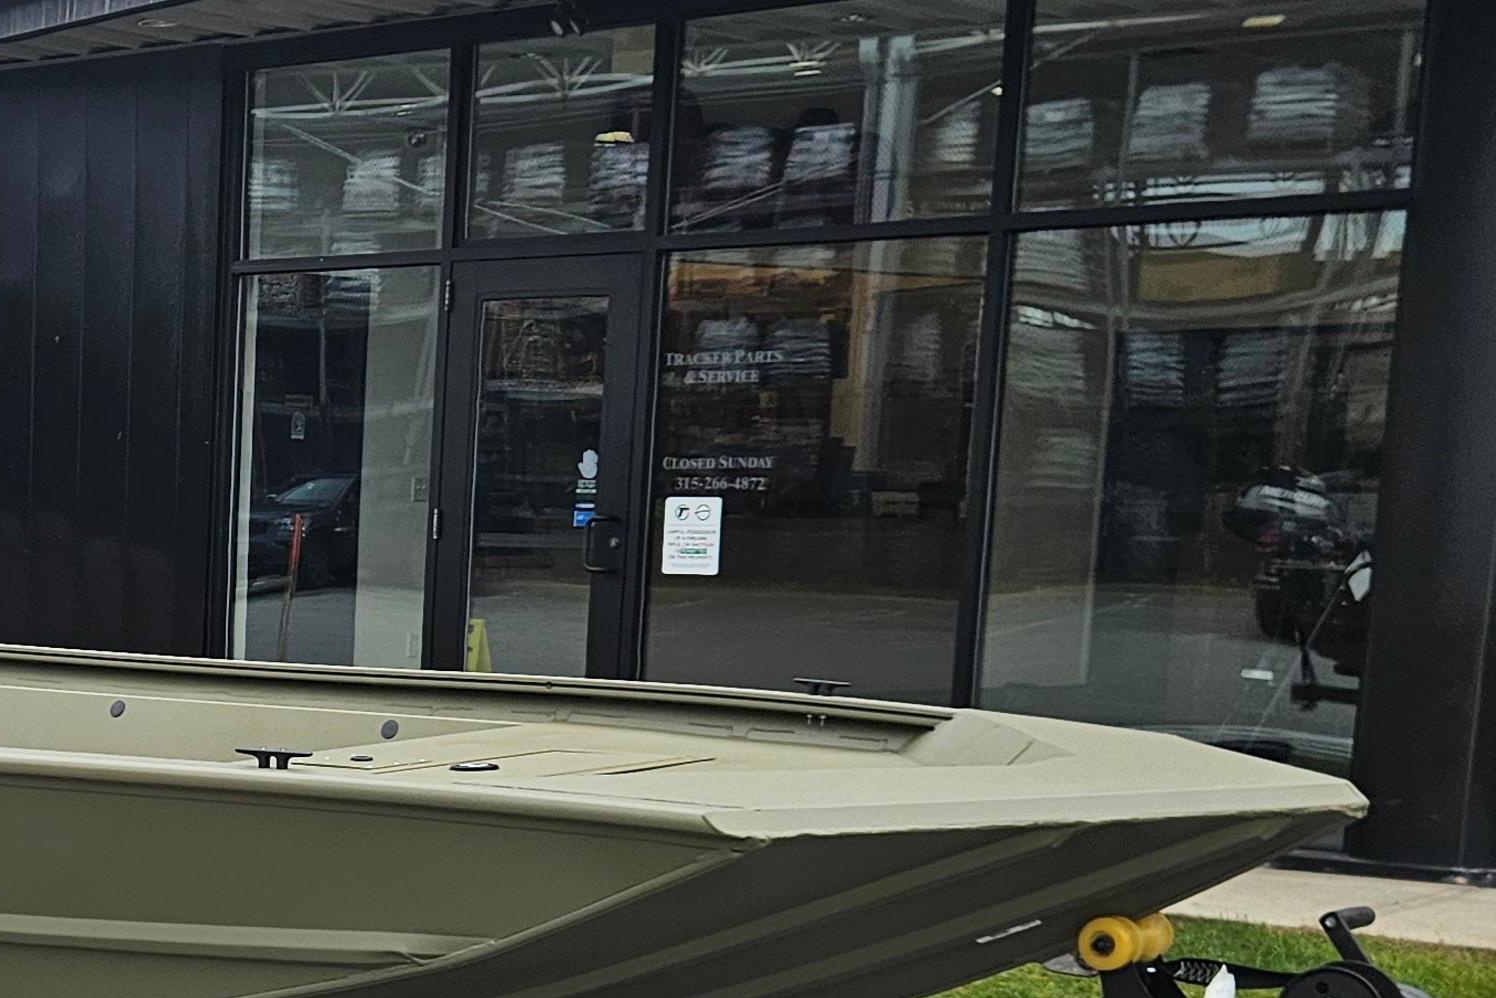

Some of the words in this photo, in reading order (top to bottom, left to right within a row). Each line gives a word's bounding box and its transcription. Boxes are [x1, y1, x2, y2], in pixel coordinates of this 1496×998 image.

[666, 350, 732, 366] TRACKER
[733, 349, 783, 364] PARTS
[683, 370, 699, 384] &
[699, 369, 760, 383] SERVICE
[662, 456, 716, 470] CLOSED
[718, 455, 775, 469] SUNDAY
[674, 476, 768, 491] 315-266-4872
